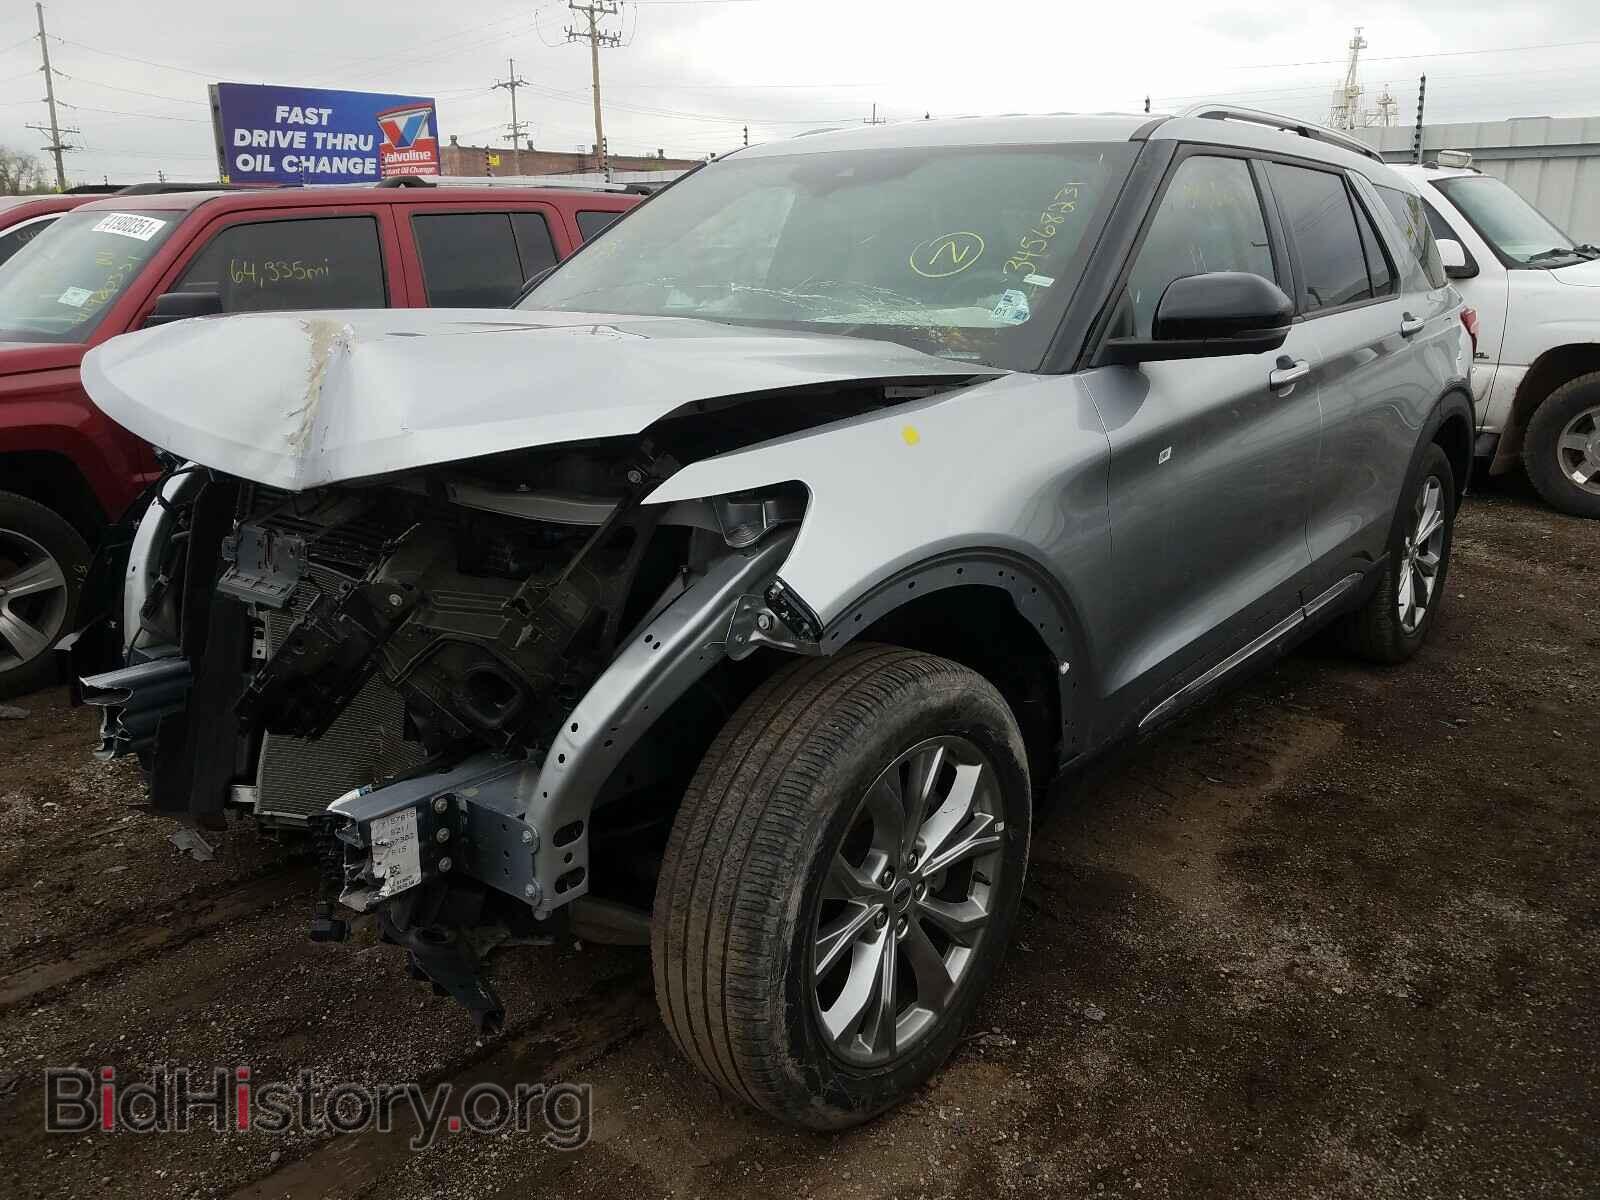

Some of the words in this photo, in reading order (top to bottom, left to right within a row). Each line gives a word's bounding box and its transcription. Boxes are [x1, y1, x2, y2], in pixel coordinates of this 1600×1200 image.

[275, 105, 333, 126] FAST
[233, 128, 306, 149] DRIVE
[312, 131, 374, 151] THRU
[235, 153, 275, 173] OIL
[282, 155, 377, 175] CHANGE
